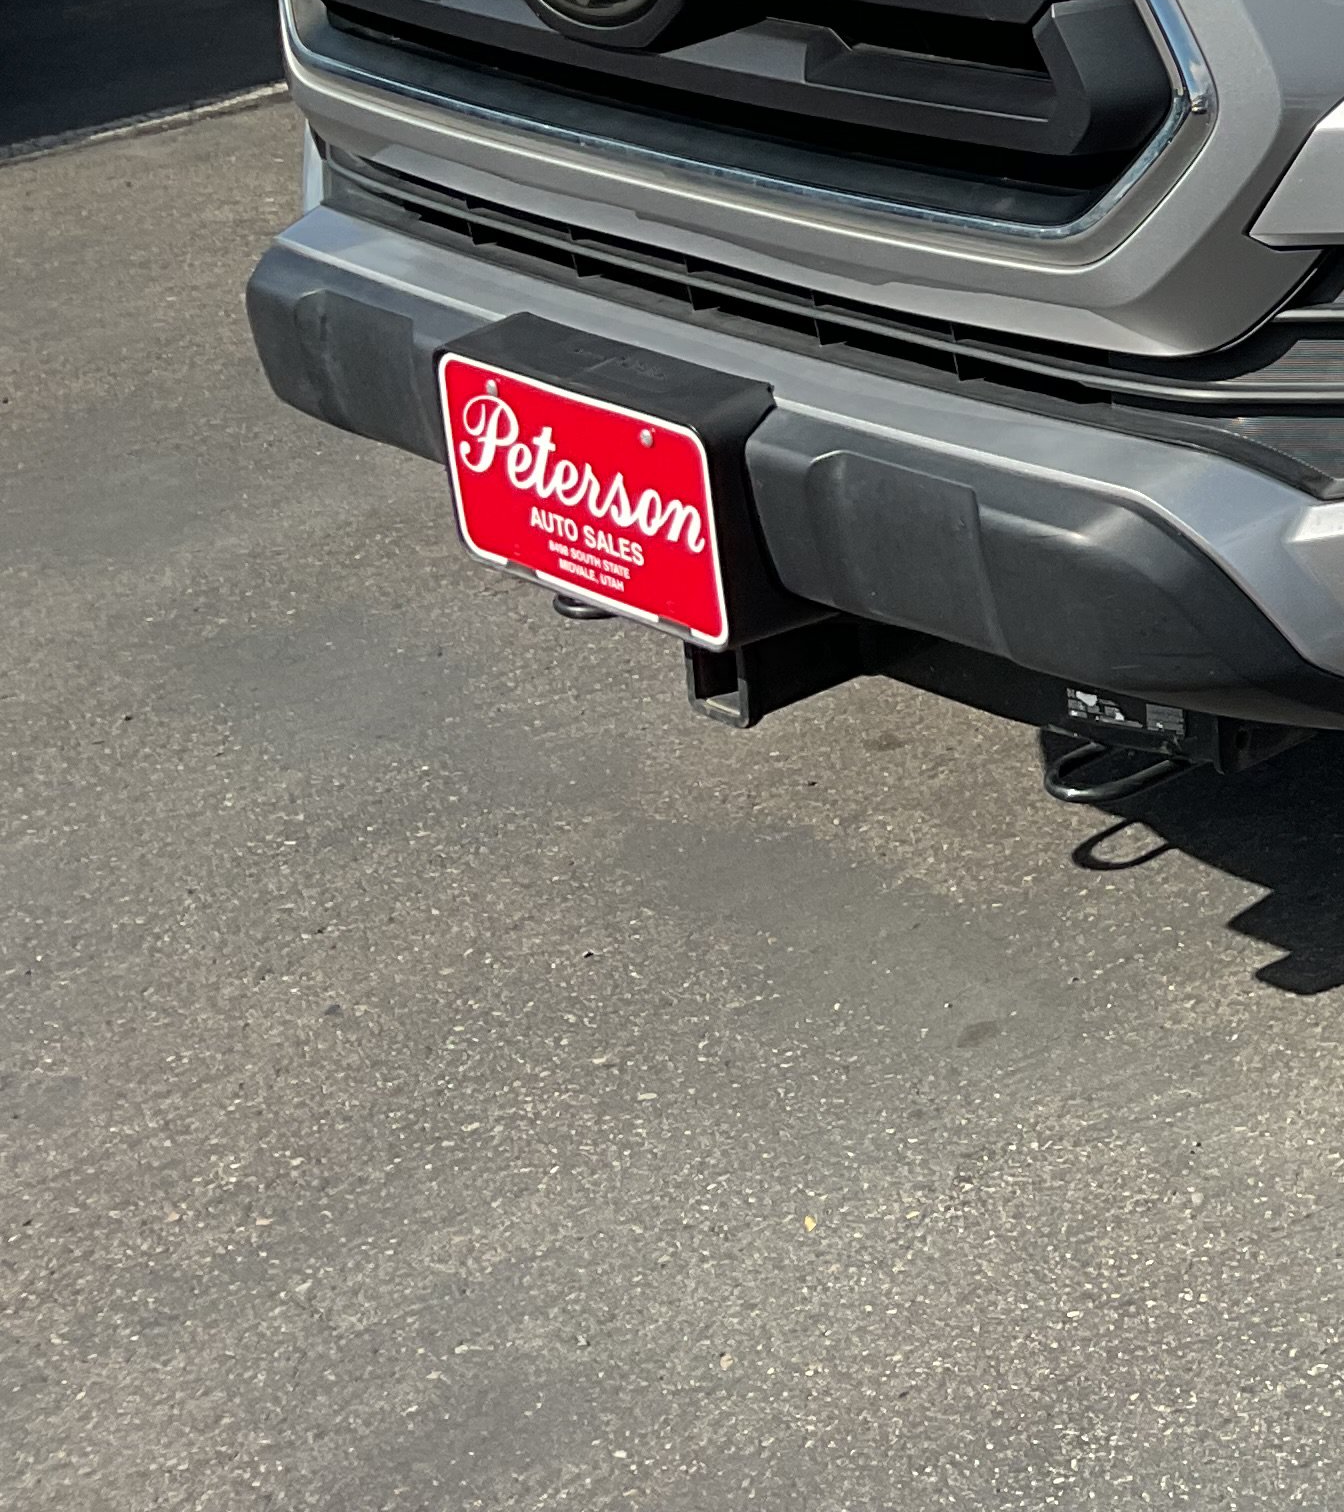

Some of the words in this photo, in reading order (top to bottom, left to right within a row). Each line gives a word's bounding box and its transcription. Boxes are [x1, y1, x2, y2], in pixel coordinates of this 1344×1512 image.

[459, 395, 706, 553] Peterson
[531, 506, 578, 542] AUTO
[583, 525, 645, 566] SALES
[570, 547, 601, 569] SOUTH
[602, 559, 631, 580] STATE
[600, 573, 625, 592] UTAH
